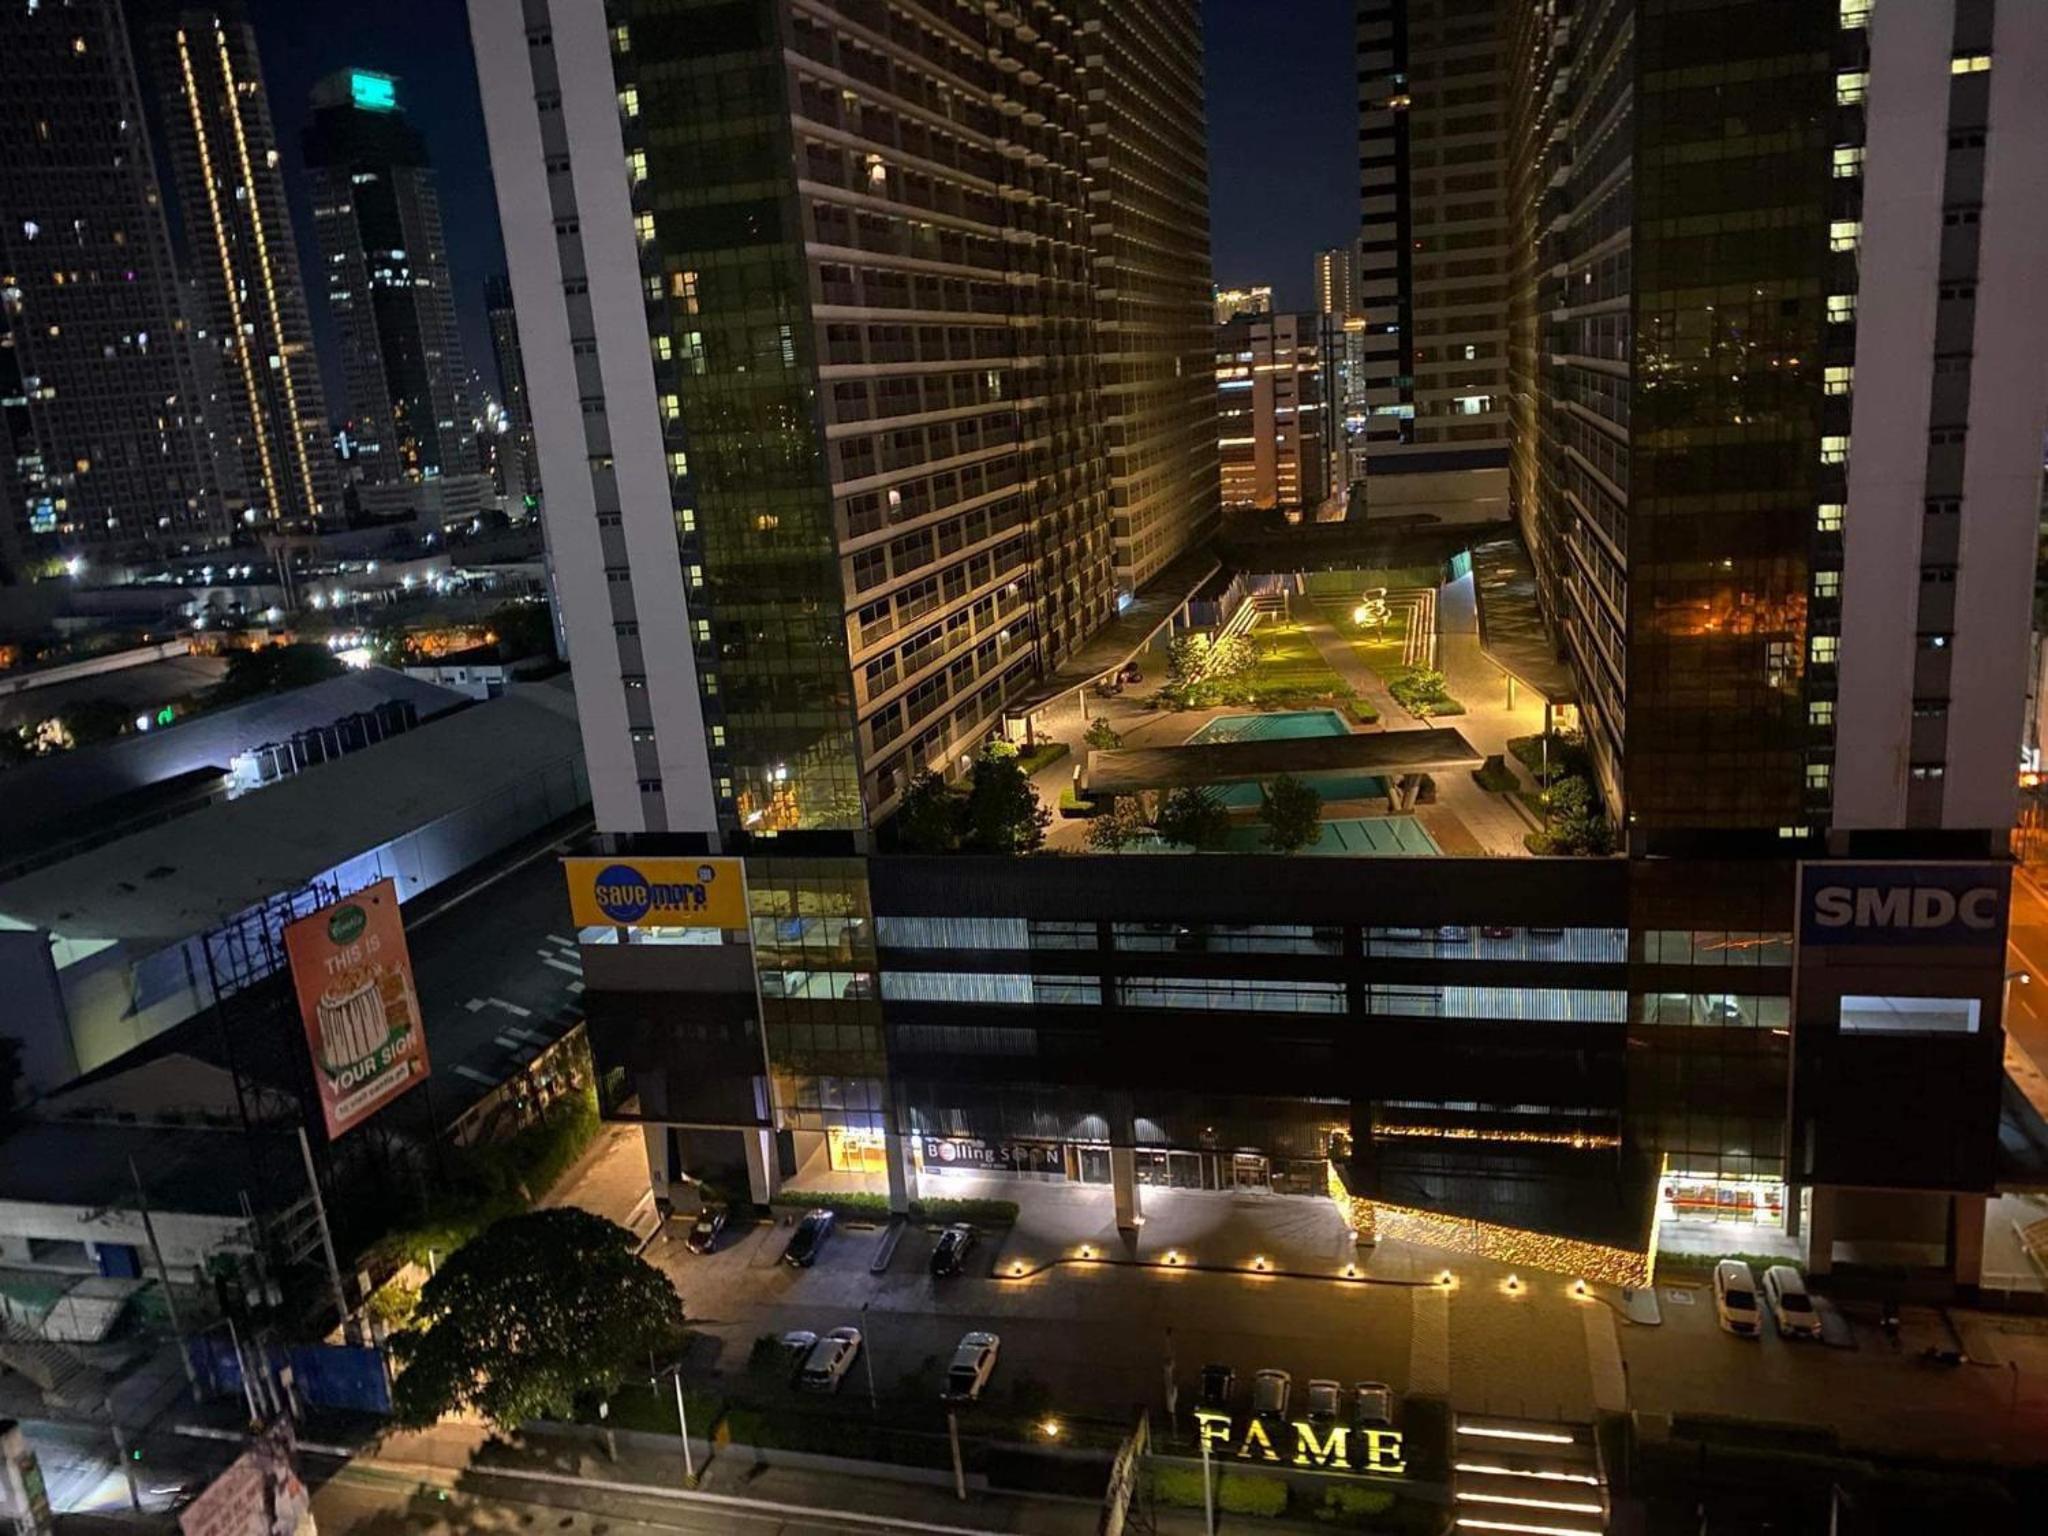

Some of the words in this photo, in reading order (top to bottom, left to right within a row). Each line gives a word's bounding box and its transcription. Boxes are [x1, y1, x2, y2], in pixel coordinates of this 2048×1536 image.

[1815, 886, 1999, 928] SMDC
[324, 944, 361, 975] THIS
[364, 934, 381, 954] IS
[328, 1056, 377, 1096] YOUR
[381, 1033, 418, 1065] SIGN
[1195, 1410, 1407, 1473] FAME
